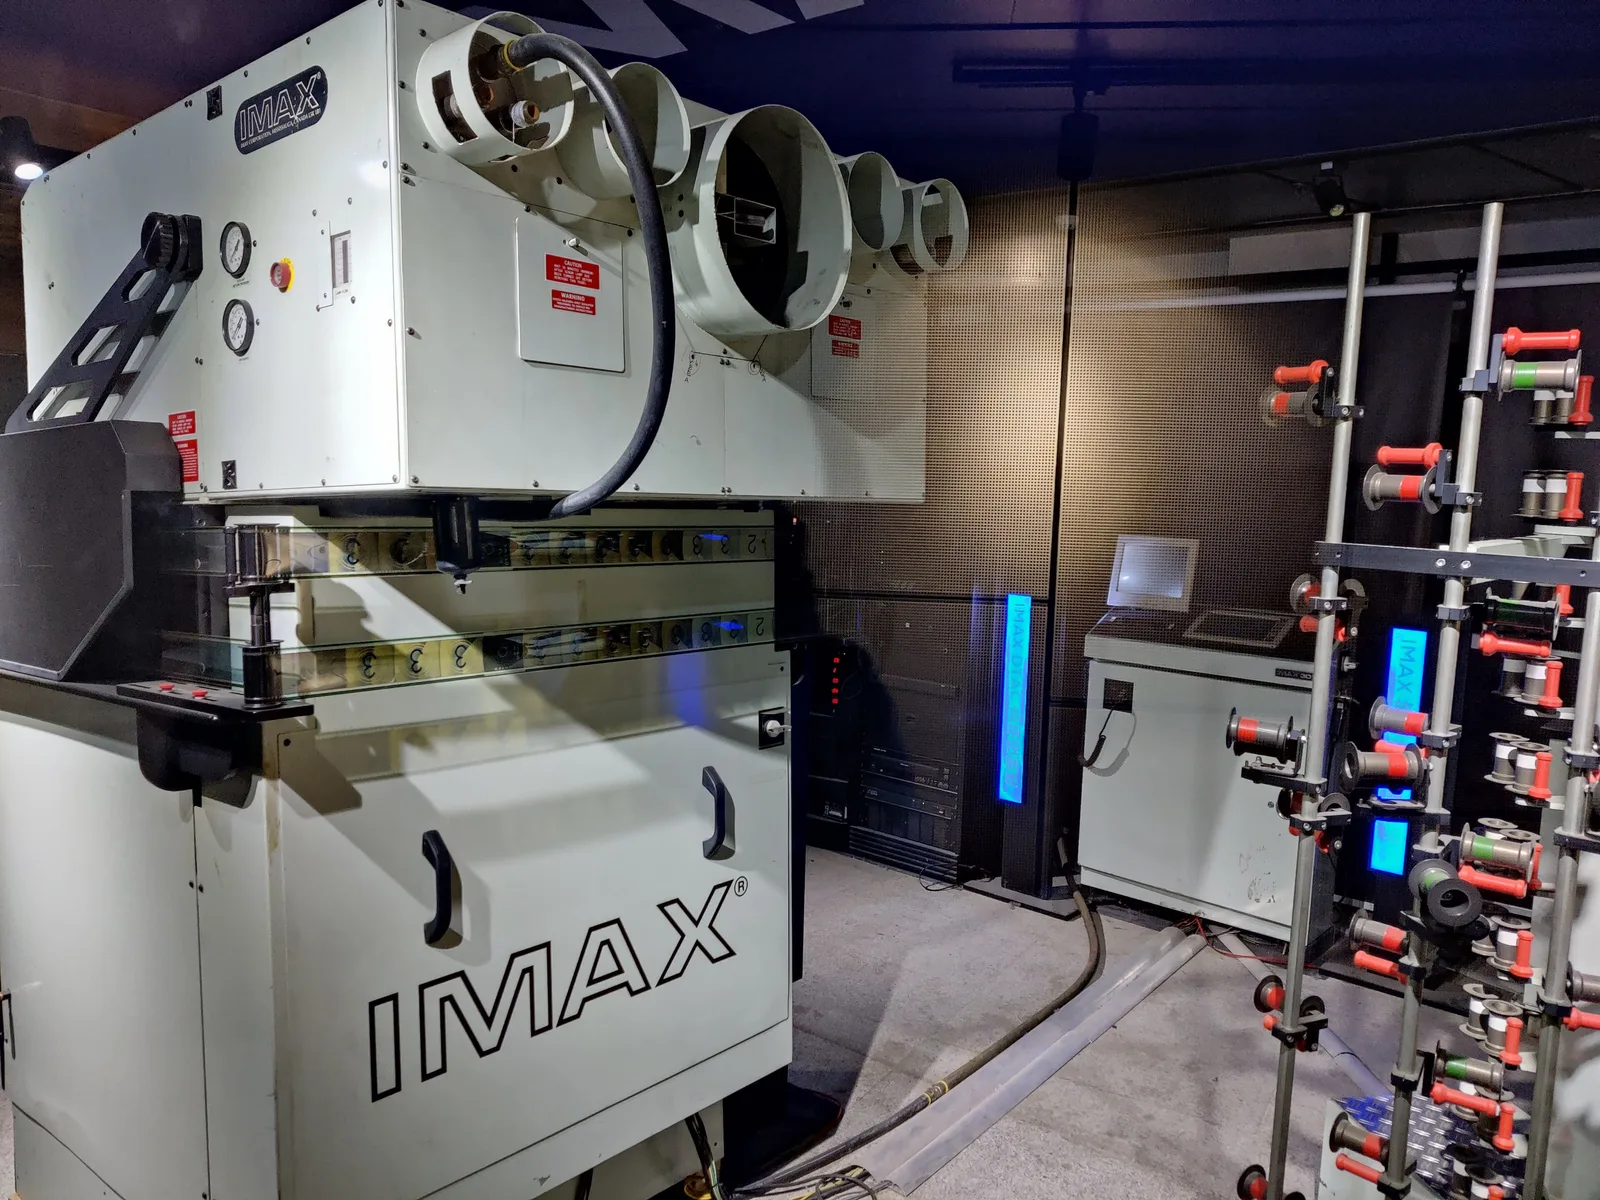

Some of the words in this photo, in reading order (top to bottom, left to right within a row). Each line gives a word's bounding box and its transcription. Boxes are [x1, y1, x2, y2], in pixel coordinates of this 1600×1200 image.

[564, 260, 582, 268] CAUTION
[561, 292, 585, 302] WARNING
[1013, 603, 1025, 648] IMAX
[1397, 640, 1417, 694] IMAX
